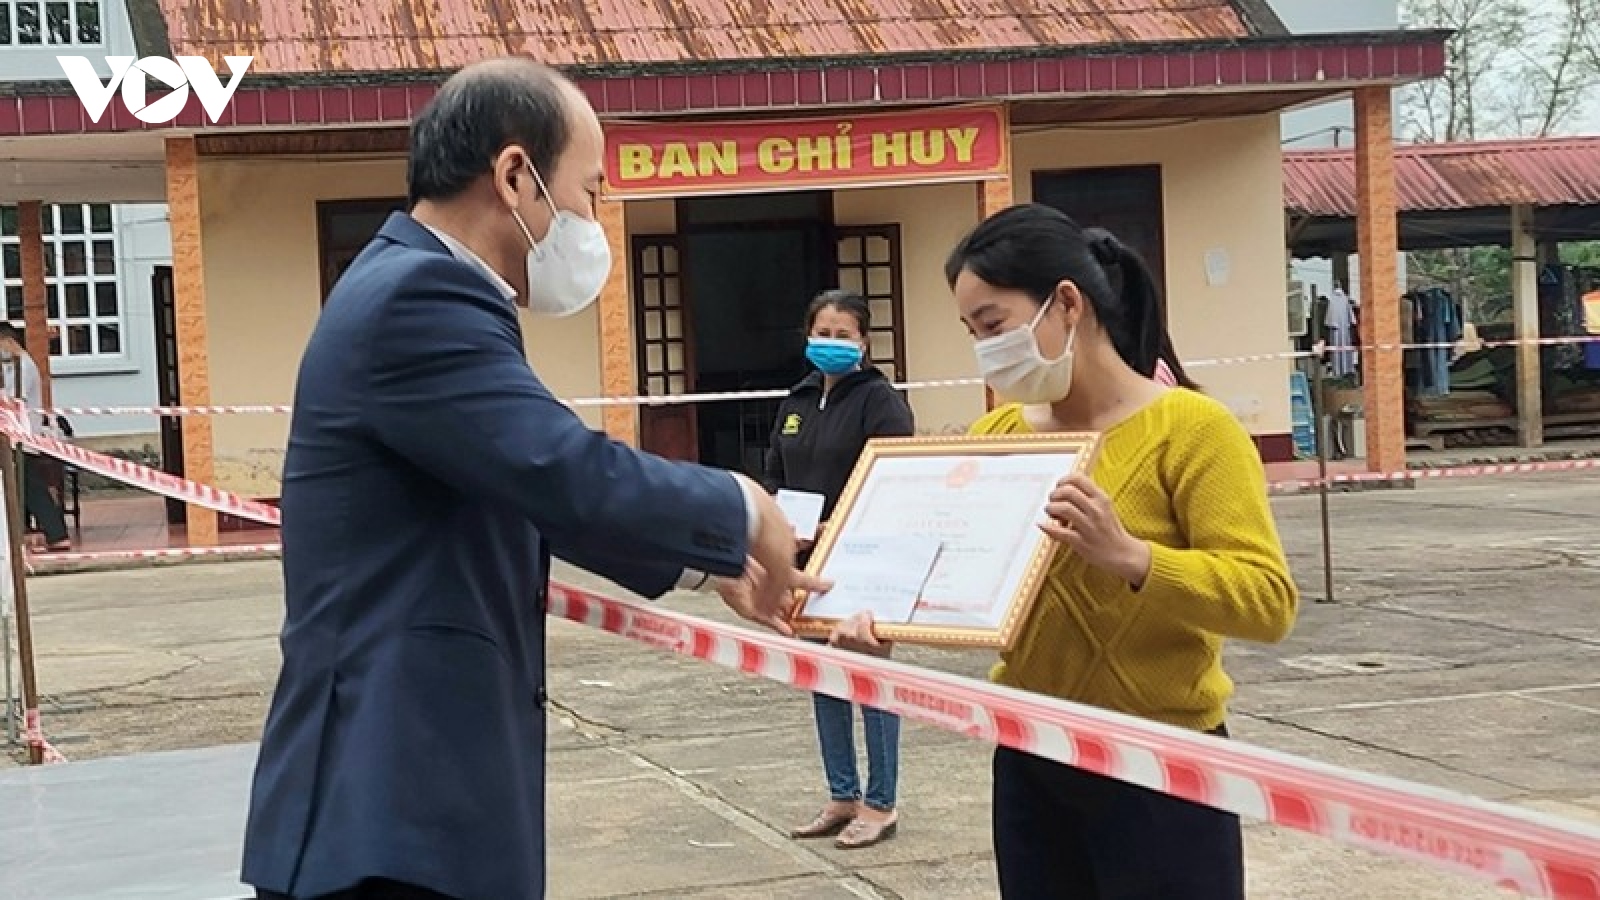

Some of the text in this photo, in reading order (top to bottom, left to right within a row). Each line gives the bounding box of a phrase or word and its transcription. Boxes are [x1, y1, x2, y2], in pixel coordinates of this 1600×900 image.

[619, 122, 979, 180] BAN CHỈ HUY
